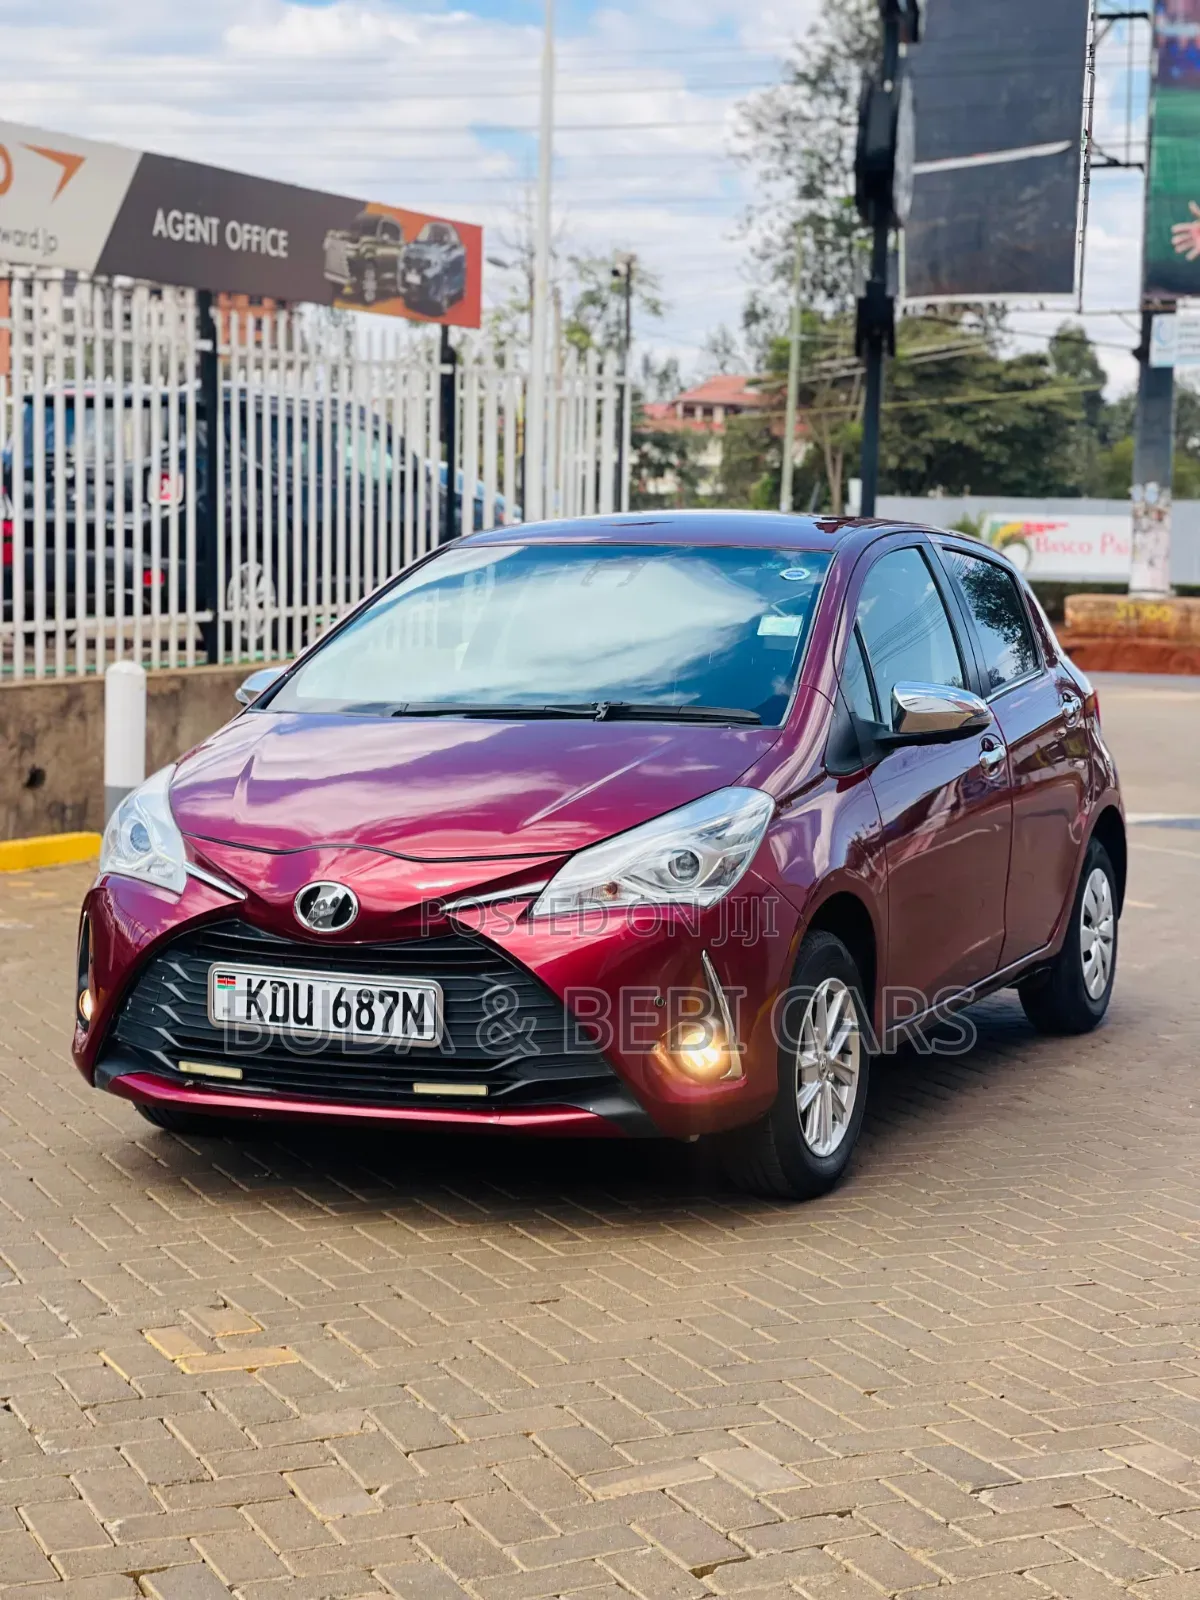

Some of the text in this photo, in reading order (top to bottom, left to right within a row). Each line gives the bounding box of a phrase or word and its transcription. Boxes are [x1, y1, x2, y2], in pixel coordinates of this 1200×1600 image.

[152, 207, 288, 258] AGENT OFFICE
[246, 977, 425, 1037] KDU 687N
